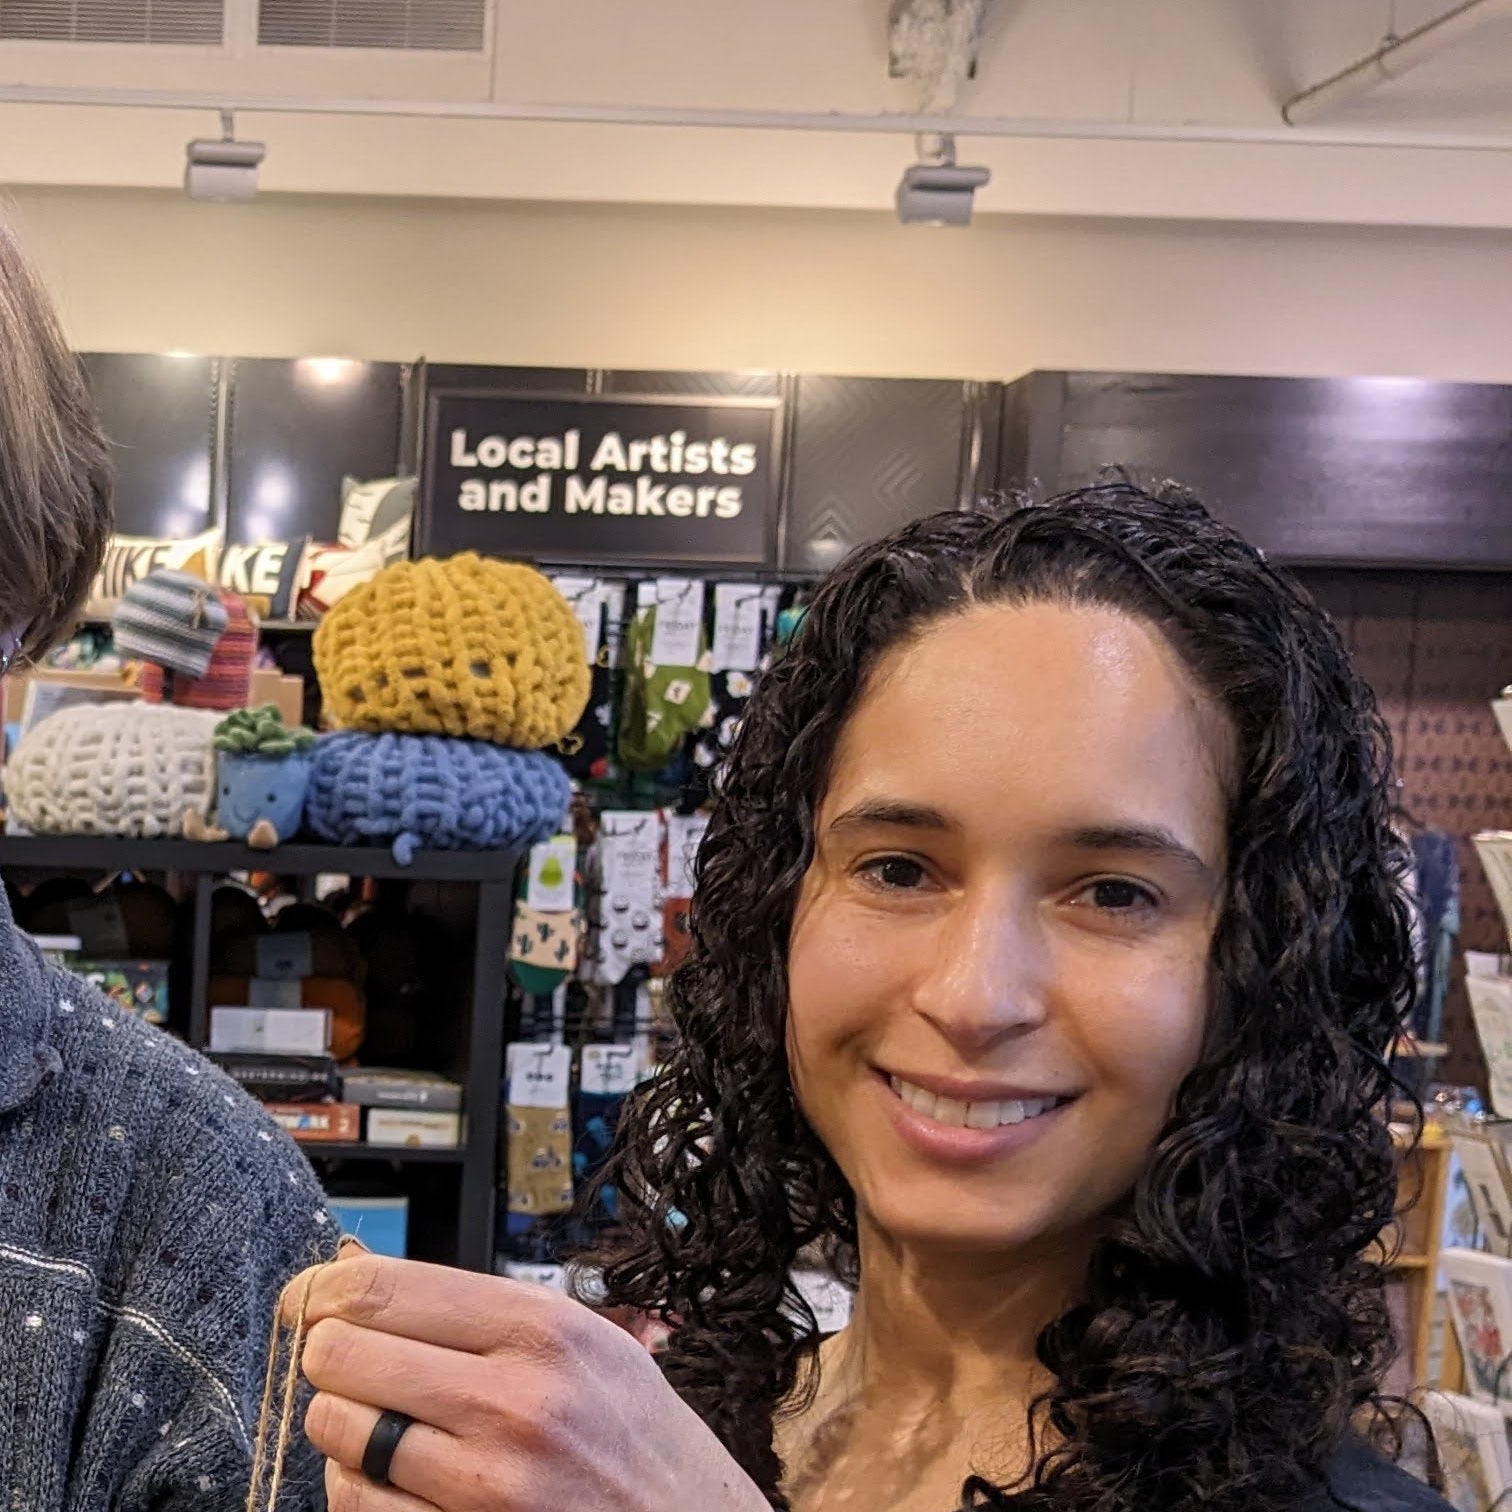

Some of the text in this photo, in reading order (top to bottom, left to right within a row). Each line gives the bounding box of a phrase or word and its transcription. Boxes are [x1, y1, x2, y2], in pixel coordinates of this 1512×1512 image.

[450, 428, 758, 475] Local Artists
[457, 472, 743, 519] and Makers
